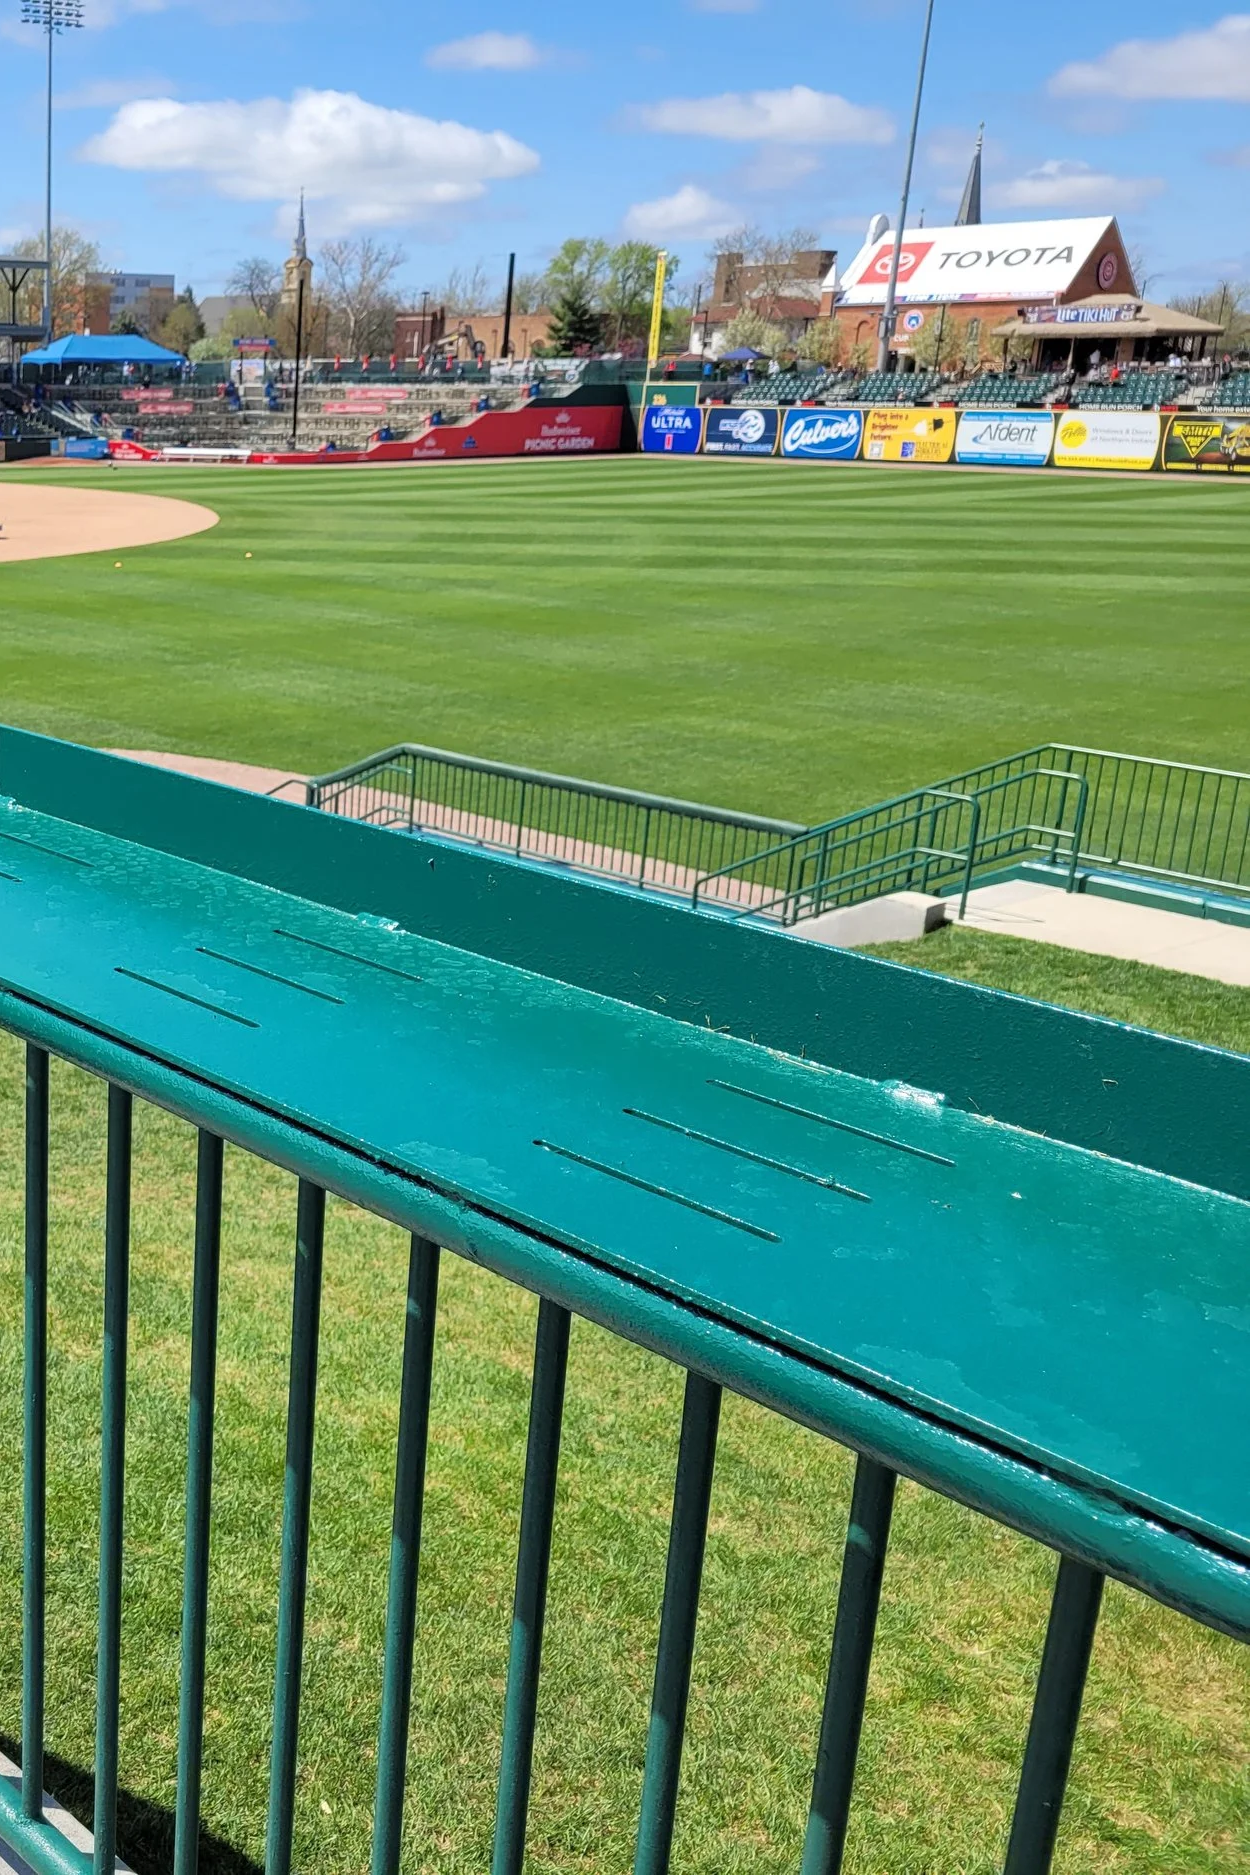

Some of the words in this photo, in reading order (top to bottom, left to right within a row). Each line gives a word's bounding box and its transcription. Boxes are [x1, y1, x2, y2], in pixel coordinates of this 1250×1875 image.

[937, 245, 1074, 271] TOYOTA
[1056, 307, 1078, 324] Lite
[1078, 308, 1098, 322] TIKI
[1098, 308, 1119, 322] HUT
[1197, 405, 1213, 413] Your
[1214, 405, 1235, 413] home
[651, 416, 693, 429] ULTRA
[873, 412, 888, 420] Plug
[890, 412, 903, 420] into
[784, 413, 860, 452] Culver's
[872, 423, 899, 431] Brighter
[979, 423, 1037, 442] Afdent
[524, 438, 557, 450] PICNIC
[558, 437, 595, 450] GARDEN
[870, 433, 893, 441] Future.
